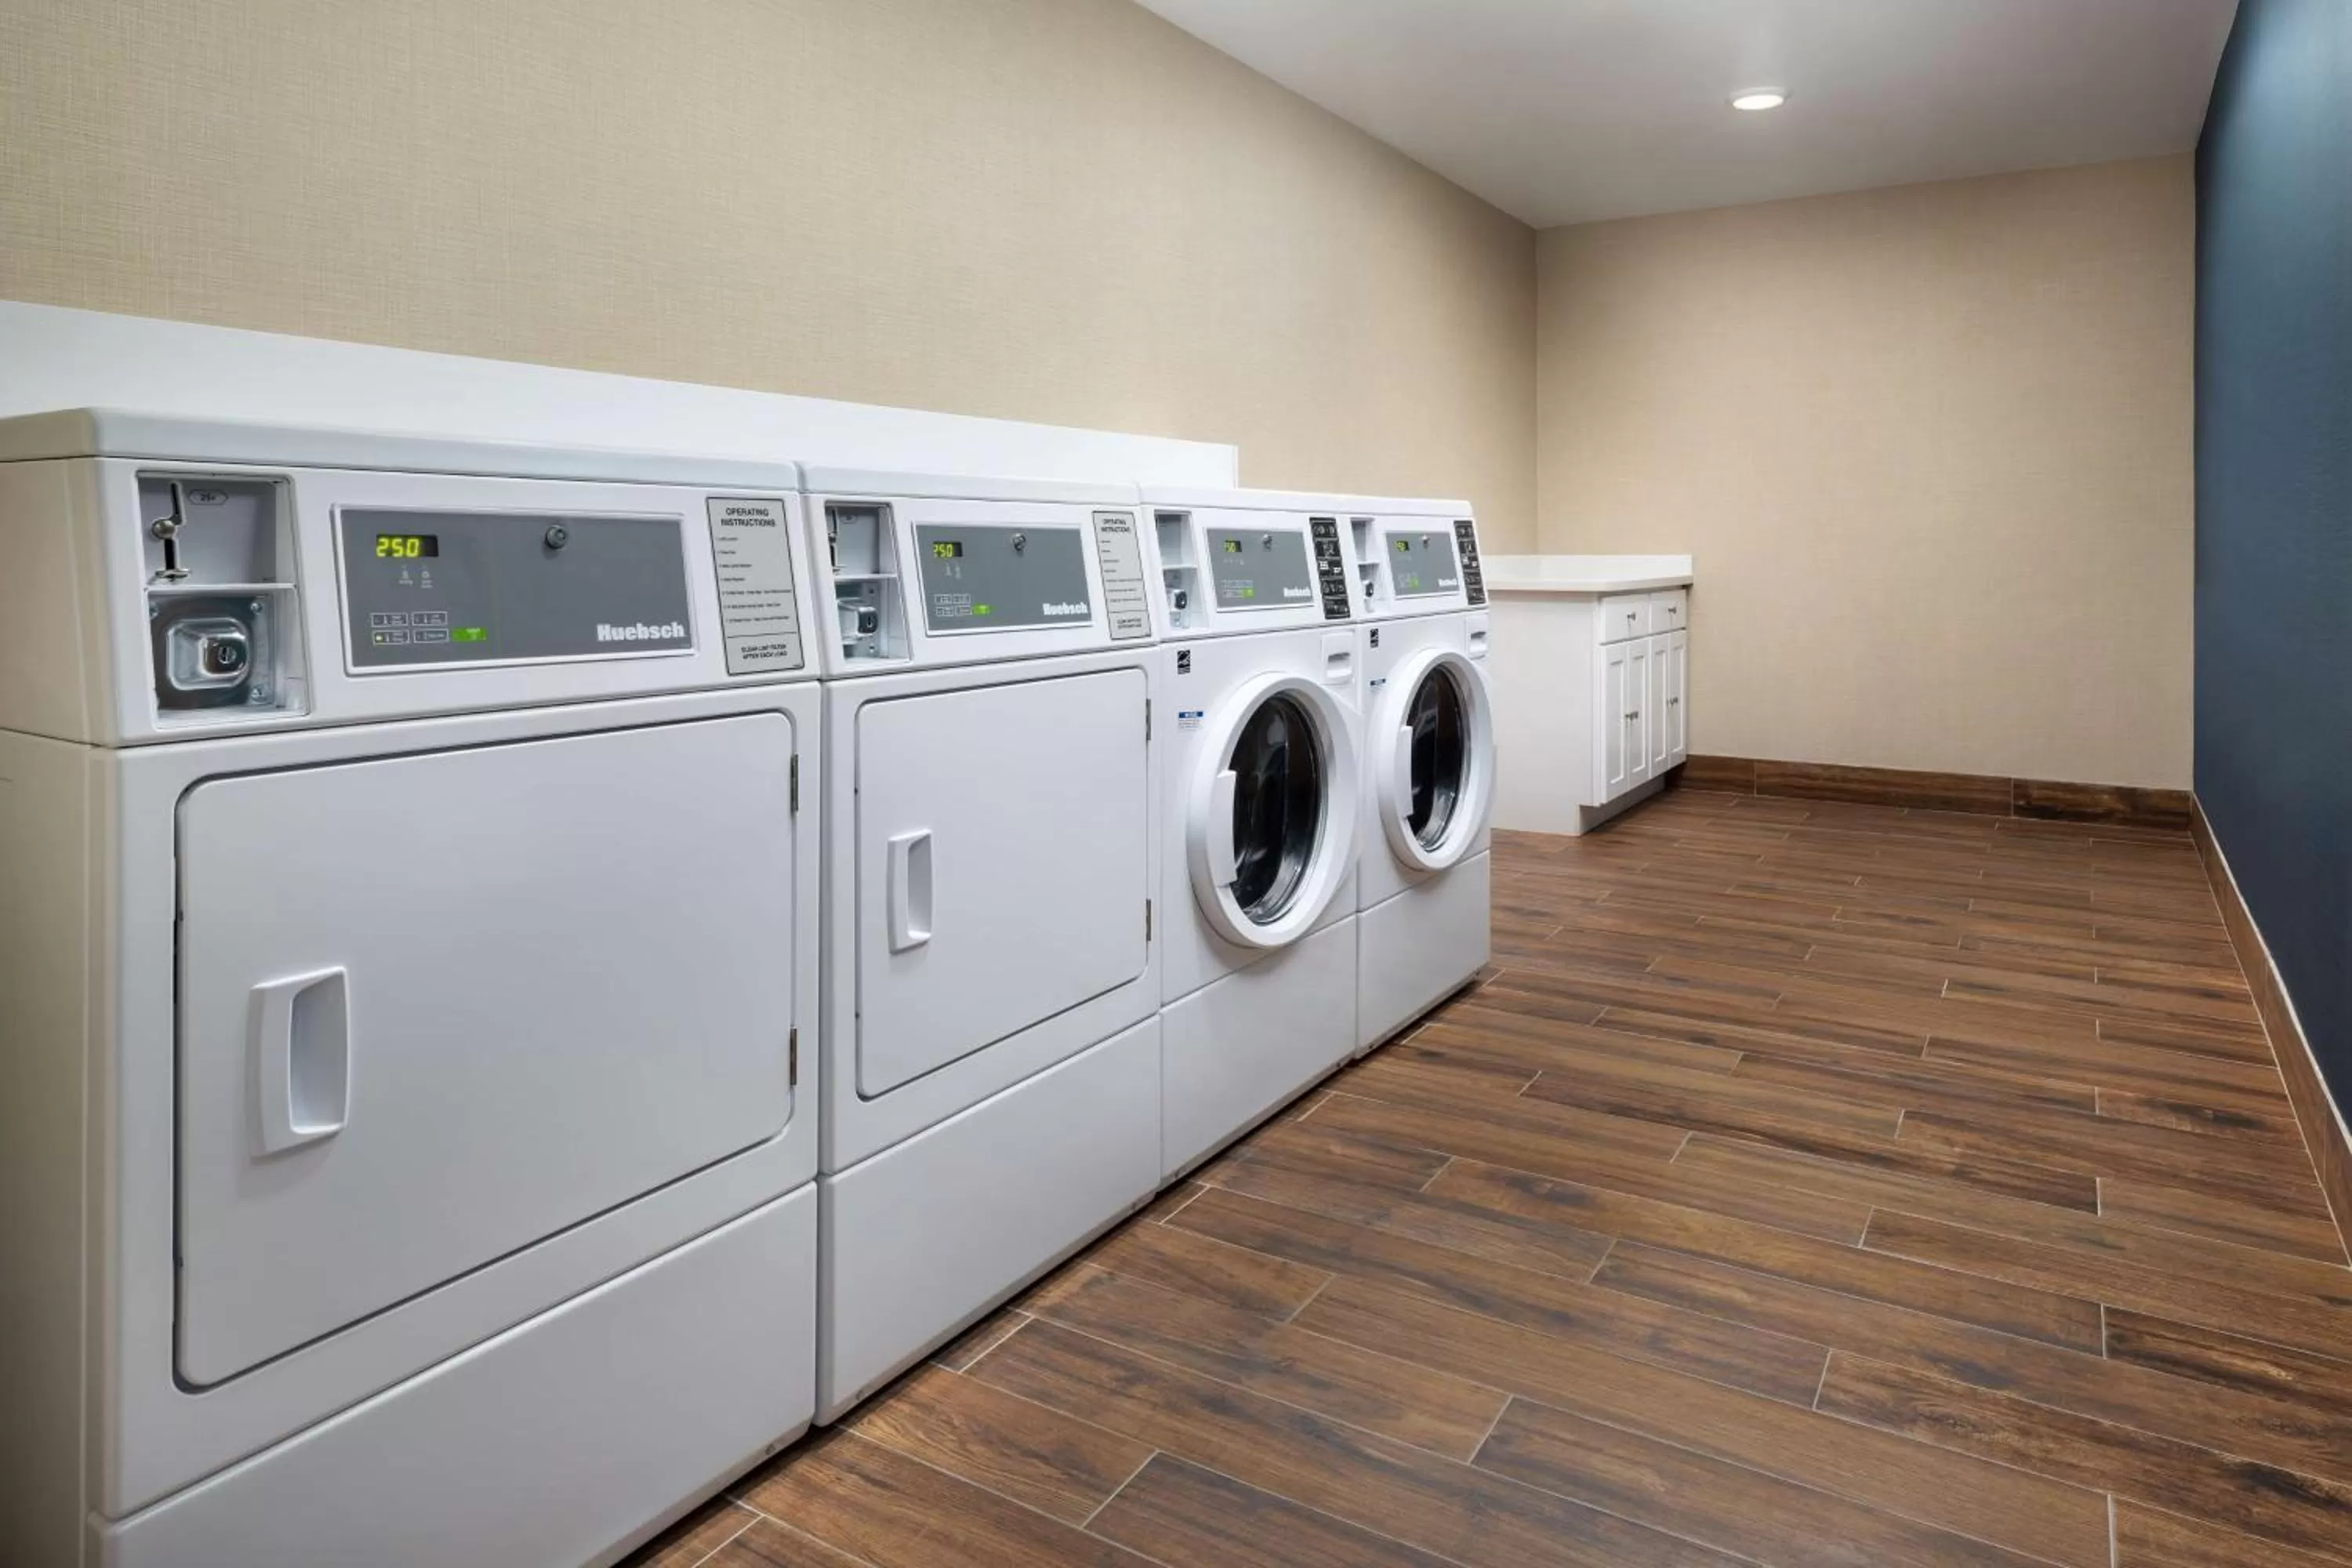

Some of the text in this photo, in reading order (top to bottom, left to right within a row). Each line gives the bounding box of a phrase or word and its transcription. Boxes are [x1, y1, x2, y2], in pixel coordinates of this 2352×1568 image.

[725, 507, 769, 517] OPERATING
[720, 518, 776, 527] INSTRUCTIONS
[376, 536, 419, 558] 250
[597, 621, 684, 641] Huebsch
